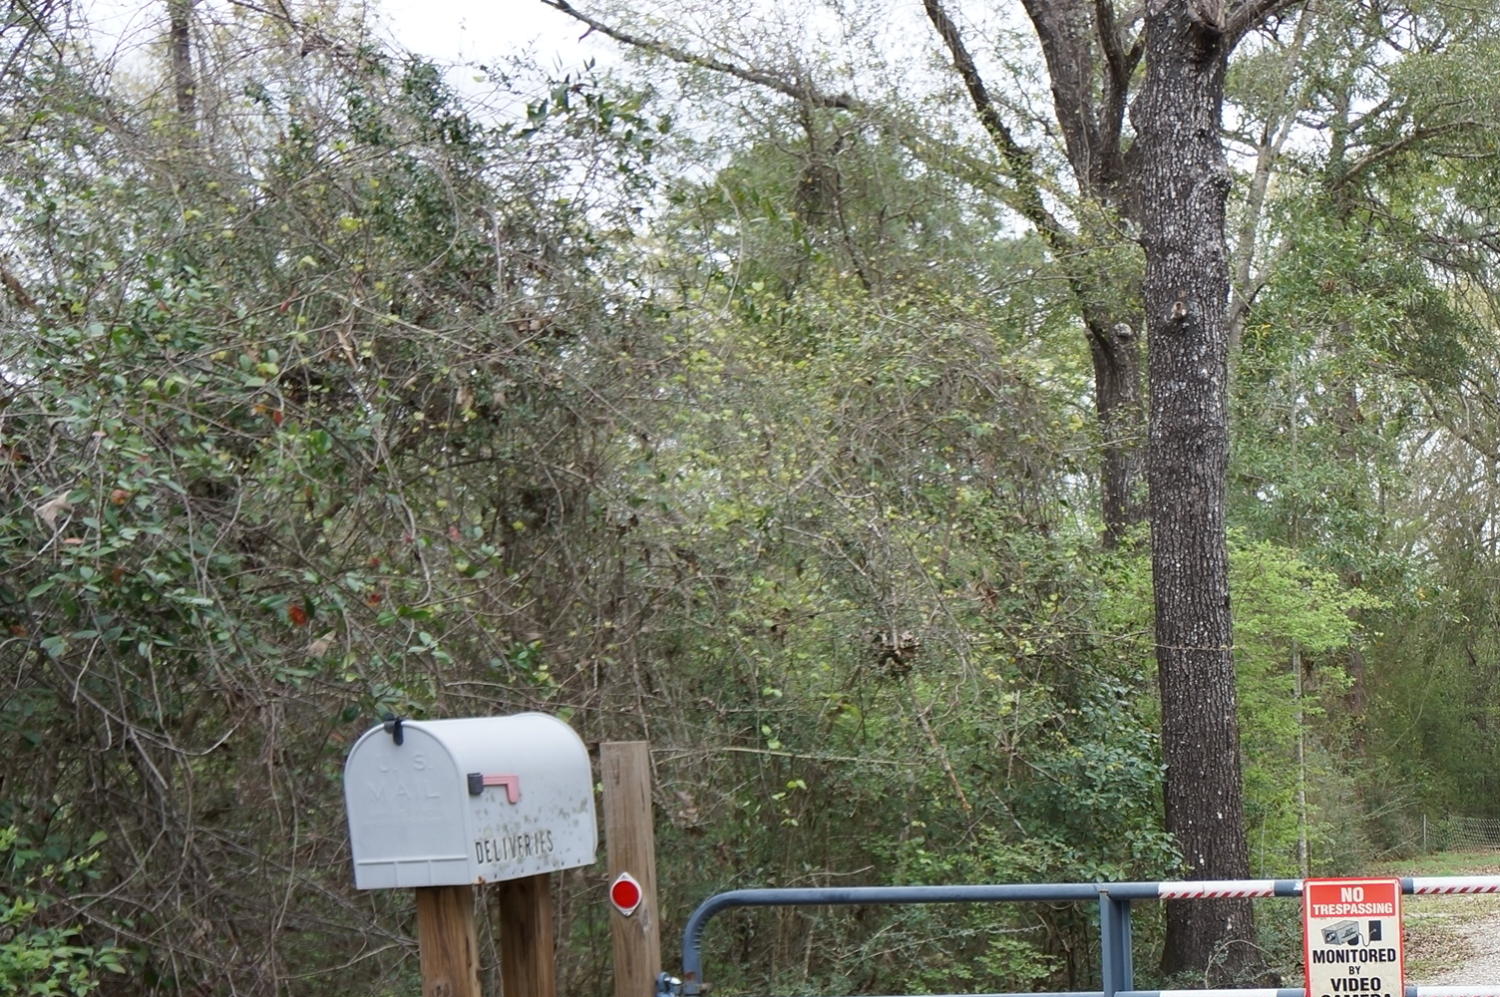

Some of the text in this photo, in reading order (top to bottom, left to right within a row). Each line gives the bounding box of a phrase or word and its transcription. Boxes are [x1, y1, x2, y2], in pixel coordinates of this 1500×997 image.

[475, 830, 554, 864] DELIVERIES
[1341, 887, 1364, 902] NO
[1313, 903, 1393, 915] TRESPASSING
[1312, 948, 1396, 964] MONITORED
[1349, 966, 1361, 975] BY
[1330, 977, 1381, 991] VIDEO
